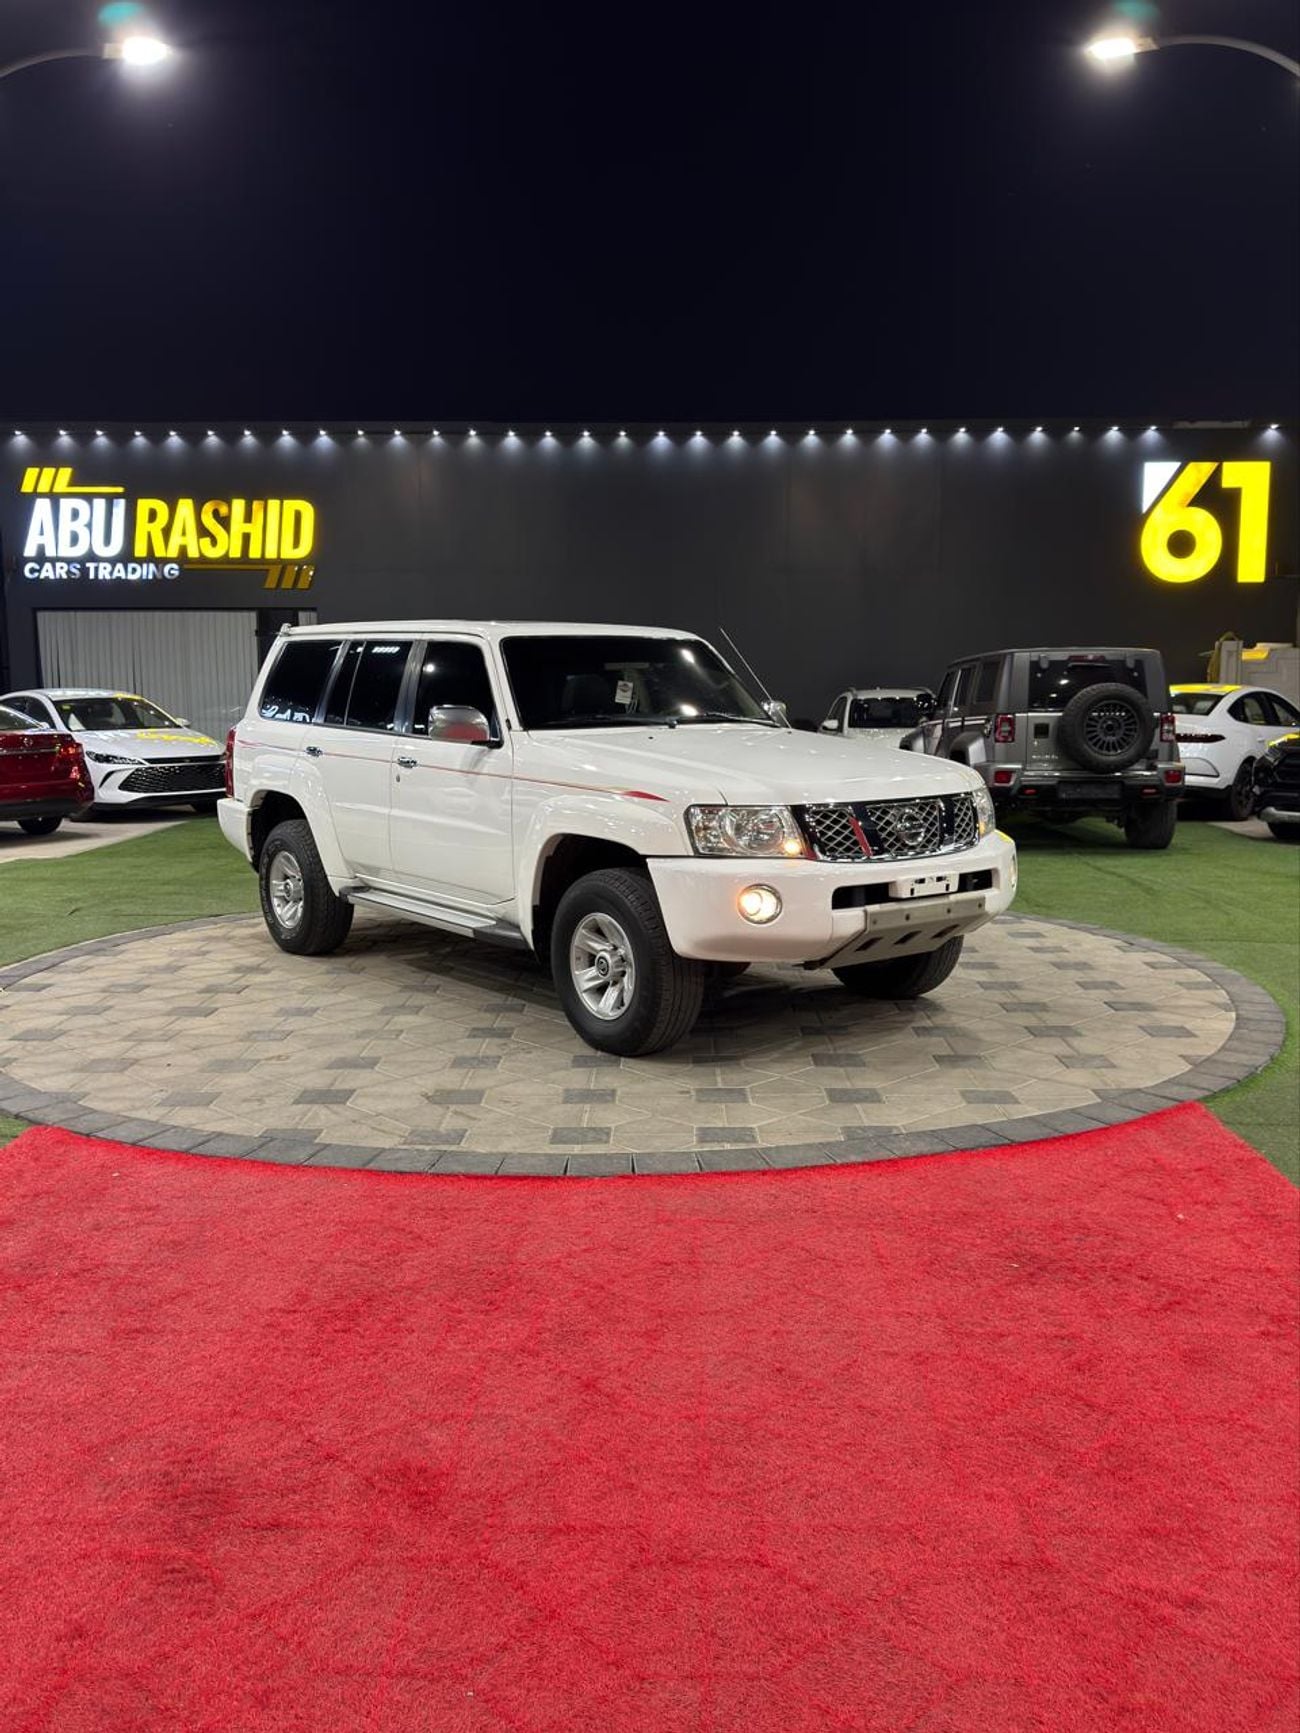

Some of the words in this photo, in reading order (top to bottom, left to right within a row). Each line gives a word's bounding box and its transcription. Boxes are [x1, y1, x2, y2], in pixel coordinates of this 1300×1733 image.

[23, 498, 125, 558] ABU
[134, 498, 315, 559] RASHID
[1140, 461, 1271, 583] 61
[23, 562, 81, 580] CARS
[86, 562, 180, 580] TRADING
